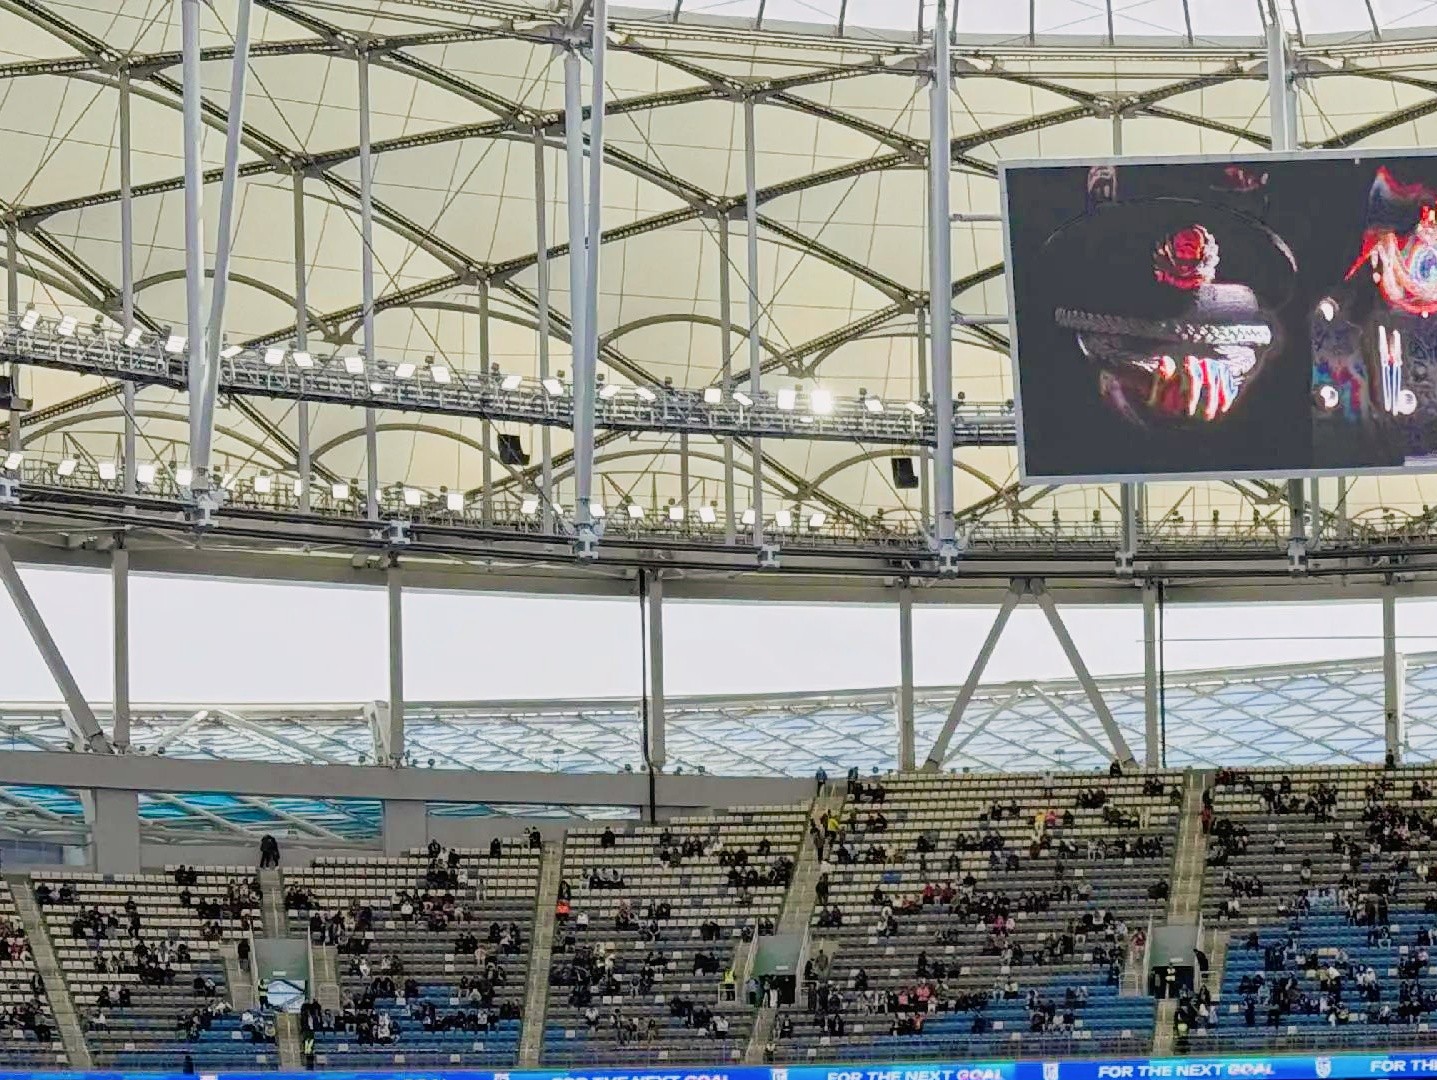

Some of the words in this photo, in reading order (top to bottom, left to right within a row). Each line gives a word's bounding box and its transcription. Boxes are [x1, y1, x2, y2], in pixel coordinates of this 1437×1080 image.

[1098, 1066, 1134, 1079] FOR
[1138, 1065, 1172, 1078] THE
[1177, 1064, 1223, 1077] NEXT
[1227, 1063, 1275, 1076] GOAL
[1370, 1060, 1406, 1072] FOR
